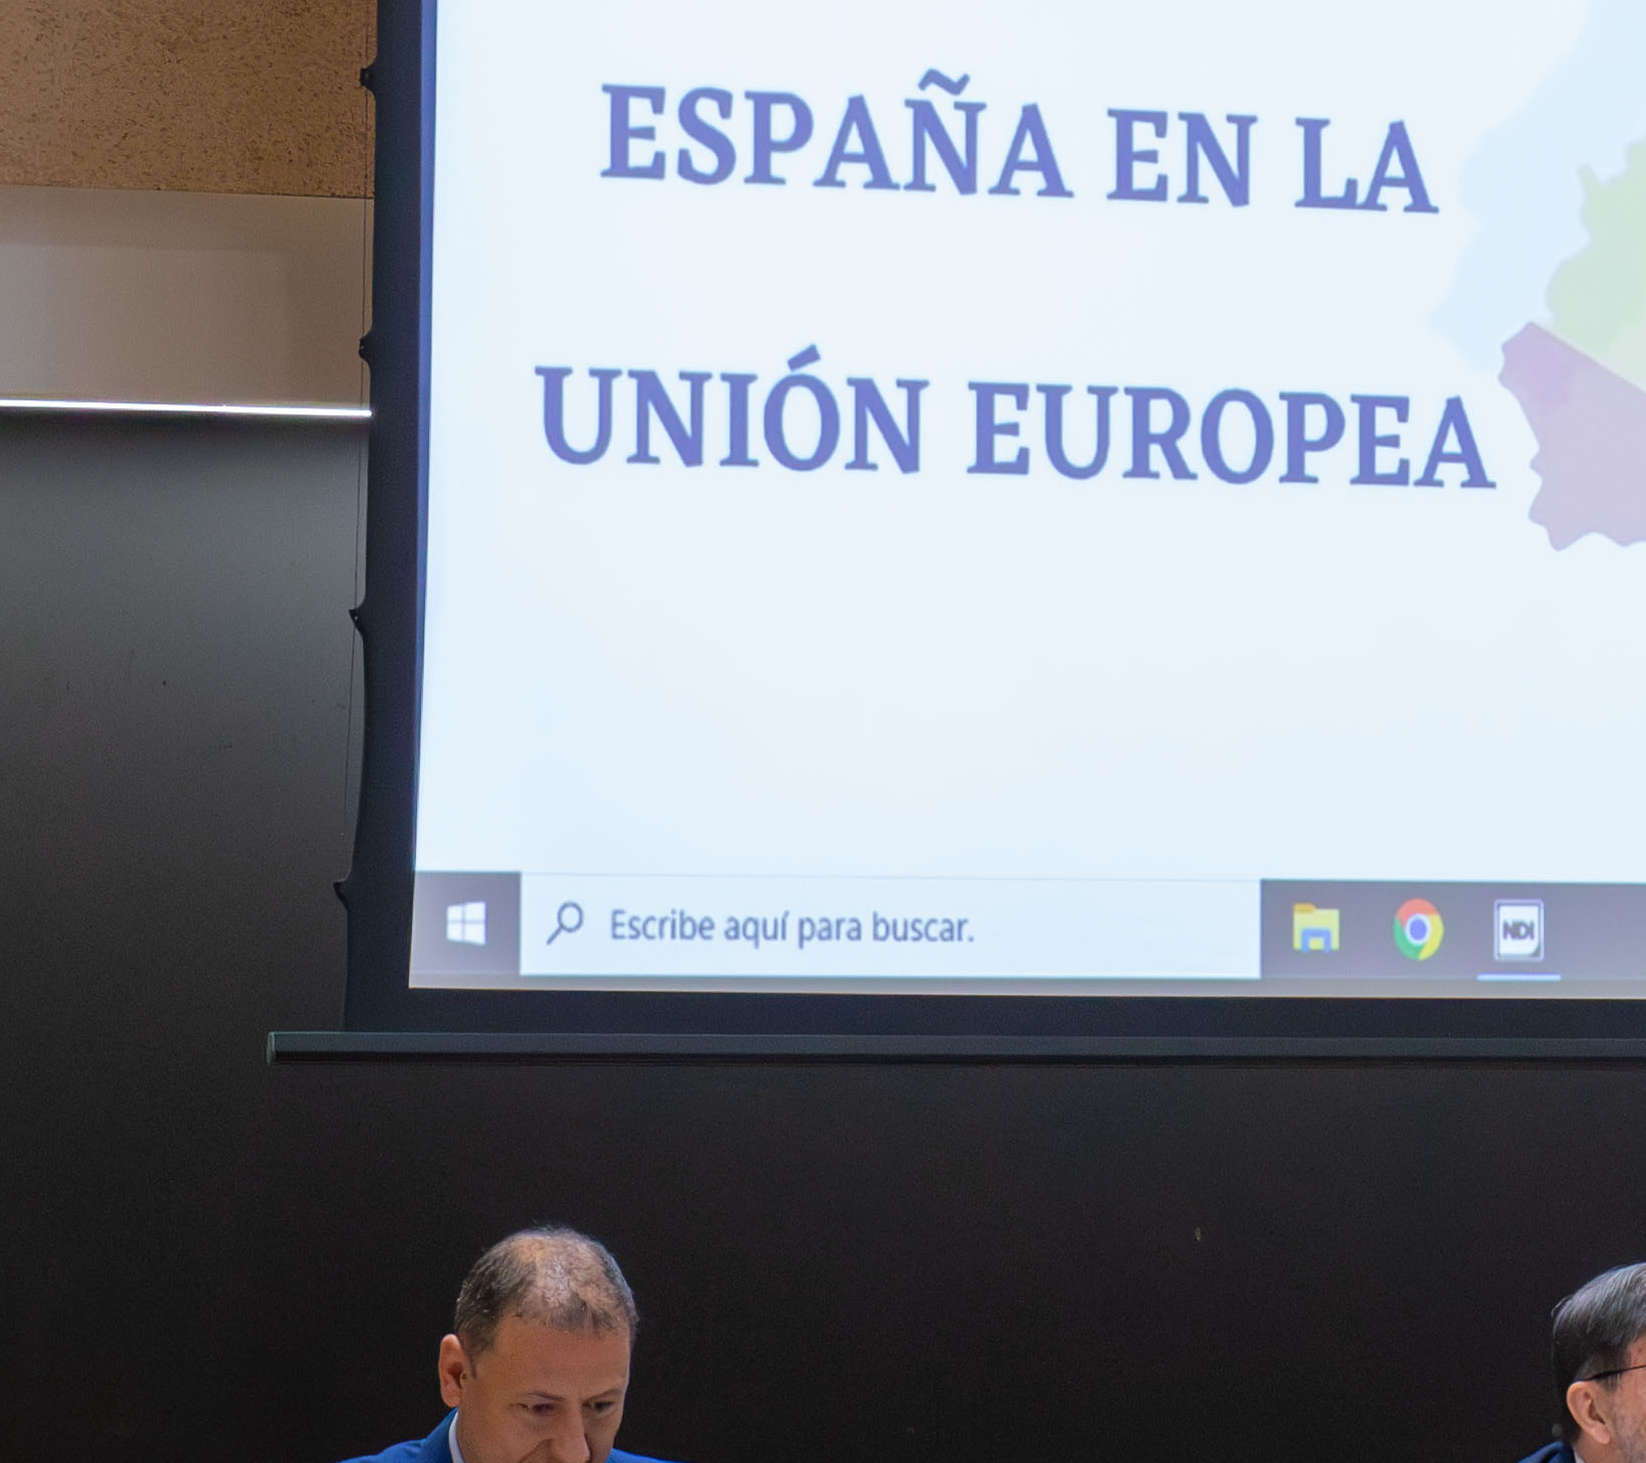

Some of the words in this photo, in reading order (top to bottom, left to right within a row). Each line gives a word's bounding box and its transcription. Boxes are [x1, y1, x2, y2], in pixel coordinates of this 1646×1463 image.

[600, 68, 1075, 198] ESPAÑA
[1106, 108, 1258, 207] EN
[1294, 118, 1440, 214] LA
[534, 343, 930, 475] UNIÓN
[966, 379, 1497, 489] EUROPEA
[610, 908, 716, 941] Escribe
[723, 909, 790, 950] aquí
[797, 915, 863, 950] para
[872, 910, 975, 943] buscar.
[1502, 919, 1535, 940] NDI
